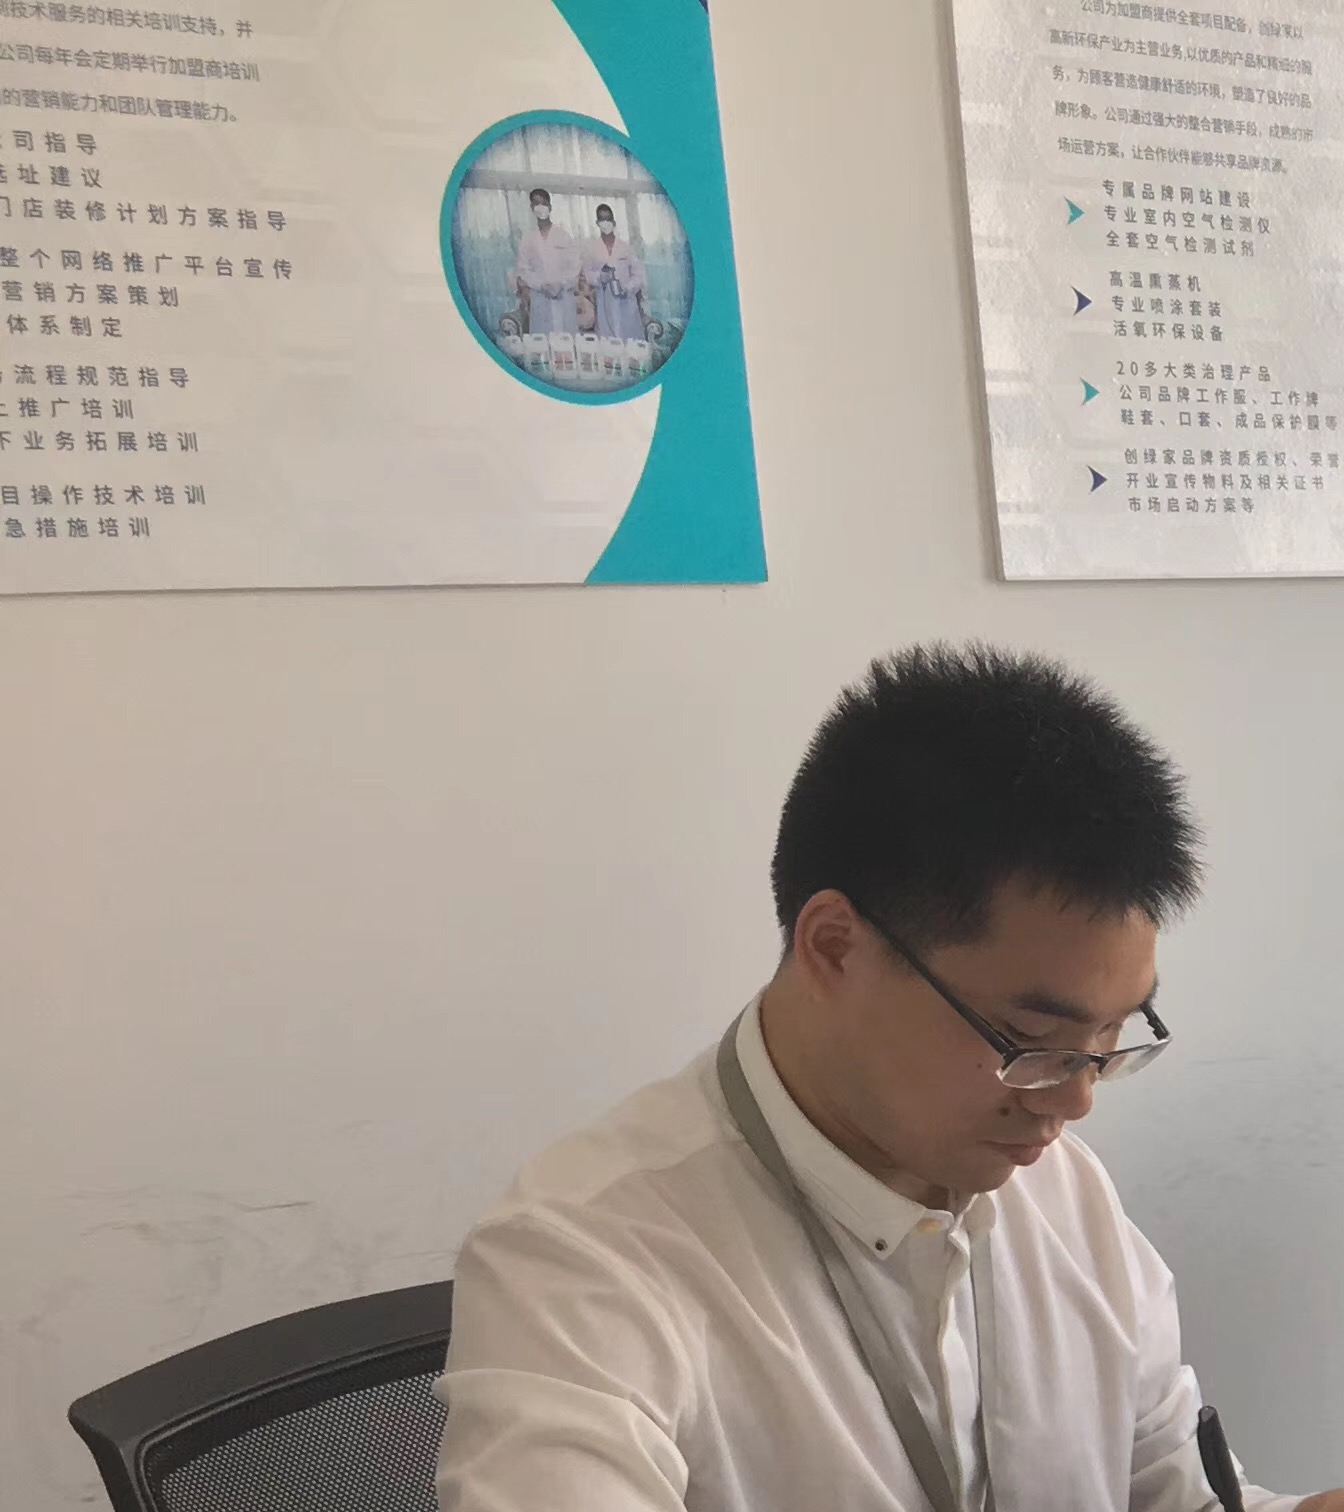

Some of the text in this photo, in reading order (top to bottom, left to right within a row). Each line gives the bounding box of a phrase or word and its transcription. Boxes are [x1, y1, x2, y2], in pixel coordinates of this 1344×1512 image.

[1103, 180, 1251, 209] 专属品牌网站建设
[1104, 205, 1271, 234] 专业室内空气检测仪
[1106, 230, 1254, 257] 全套空气检测试剂
[0, 247, 293, 280] 整个网络推广平台宣传
[2, 280, 178, 307] 营销方案策划
[6, 314, 123, 338] 体系制定
[1114, 320, 1223, 342] 活氧环保设备
[1117, 361, 1271, 382] 20多大类治理产品
[1, 484, 206, 505] 目操作技术培训
[1128, 496, 1254, 514] 市场启动方案等
[5, 517, 150, 538] 急措施培训
